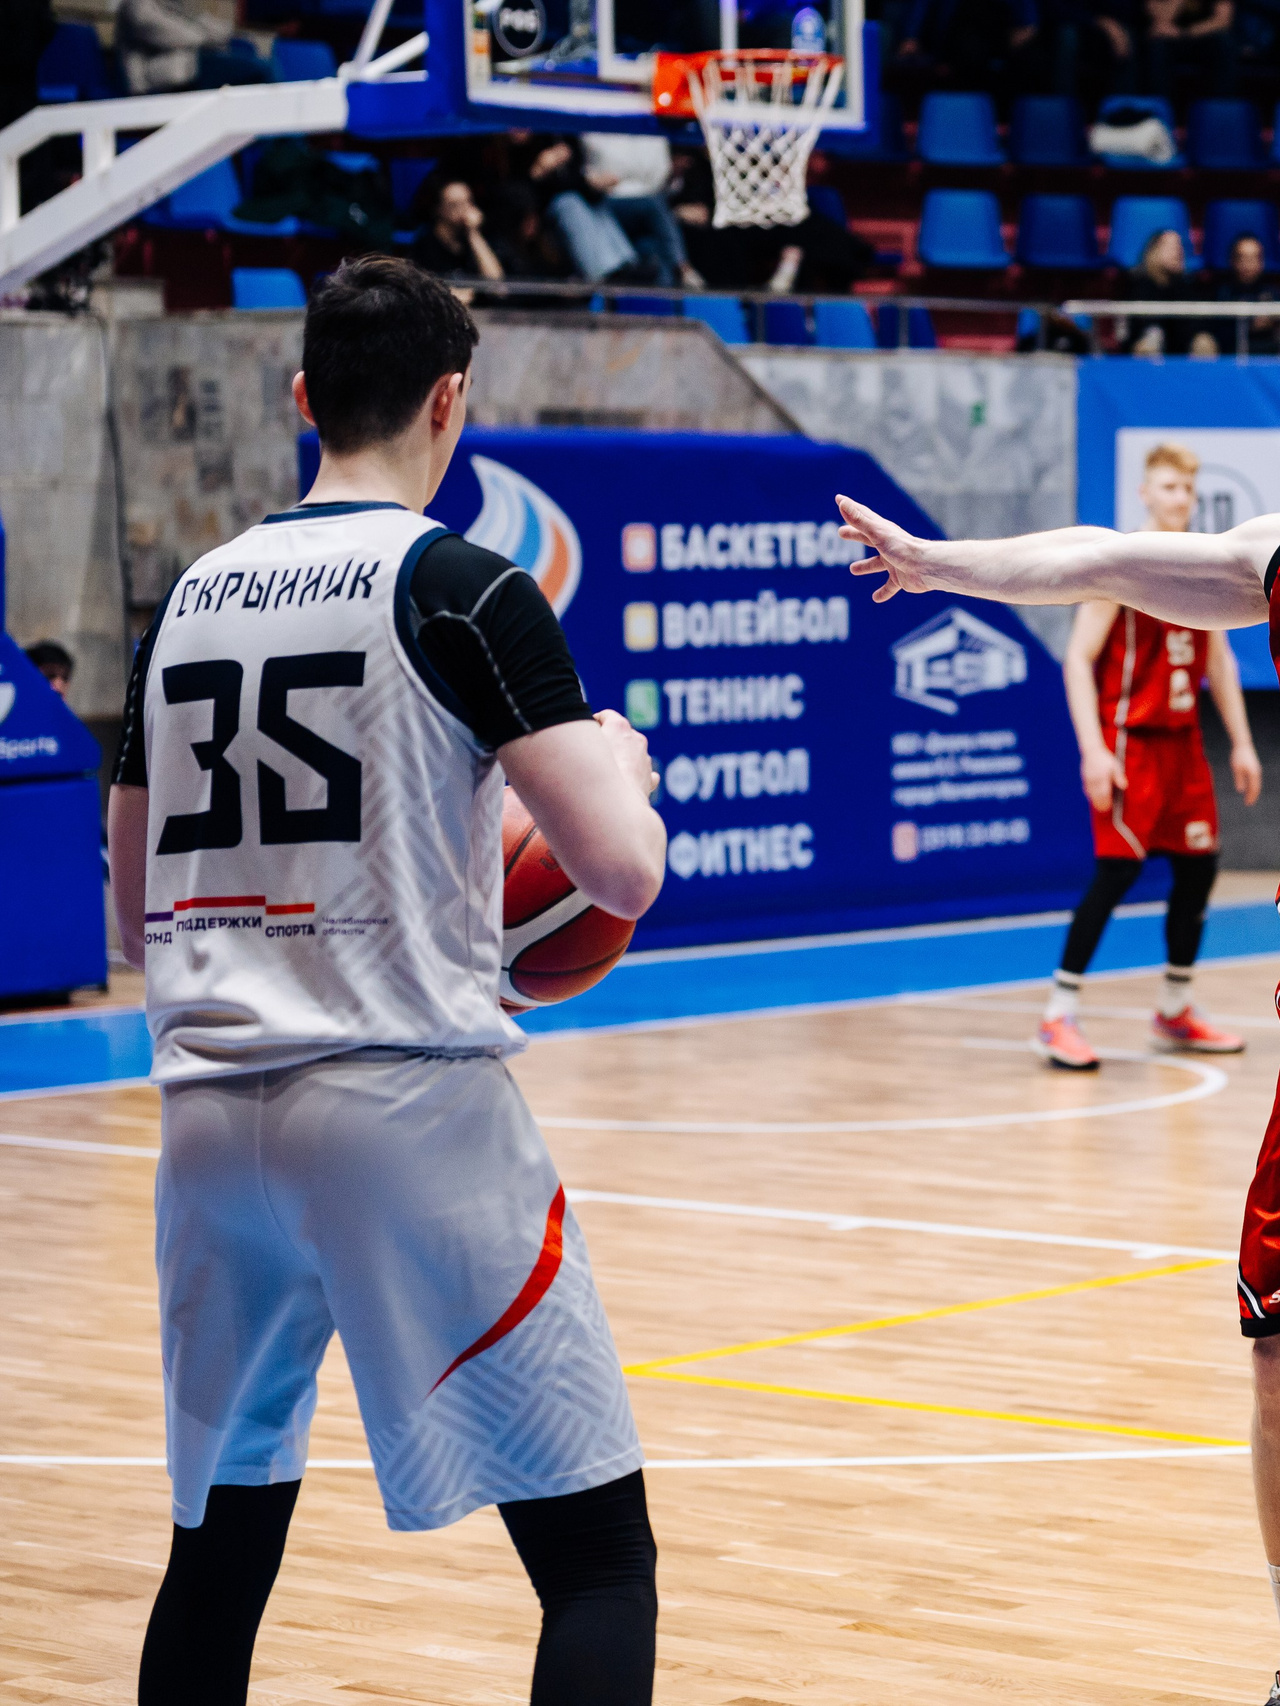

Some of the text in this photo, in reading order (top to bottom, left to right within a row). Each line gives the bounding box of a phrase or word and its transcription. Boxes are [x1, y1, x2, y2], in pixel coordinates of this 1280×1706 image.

[660, 522, 865, 571] БАСКЕТБОЛ
[176, 557, 382, 618] СКРЫННИК
[662, 590, 850, 649] ВОЛЕЙБОЛ
[663, 673, 806, 725] ТЕННИС
[156, 651, 367, 855] 35
[665, 748, 811, 803] ФУТБОЛ
[669, 823, 815, 879] ФИТНЕС
[145, 931, 173, 945] ОНД
[265, 924, 316, 938] СПОРТА
